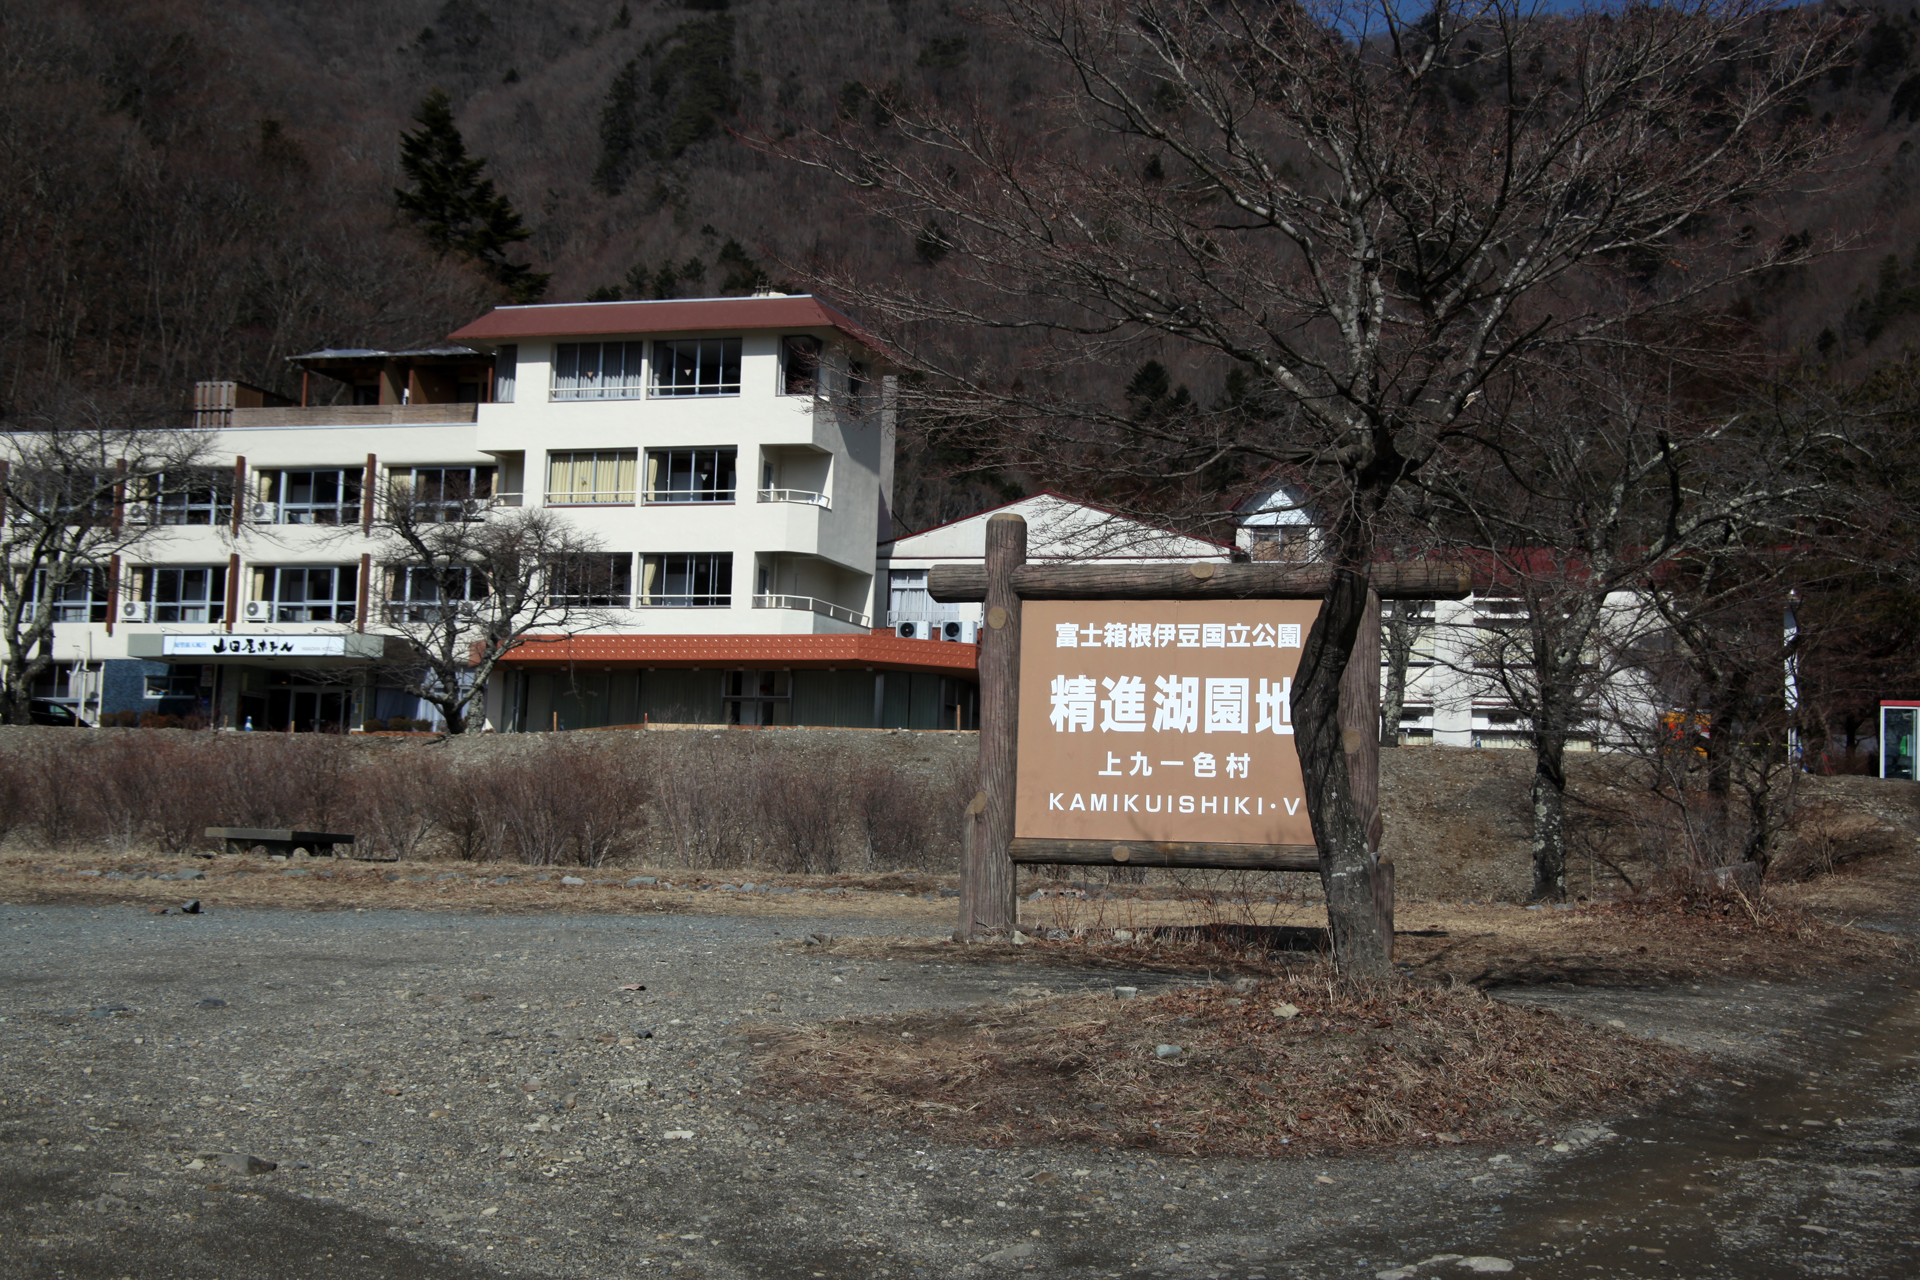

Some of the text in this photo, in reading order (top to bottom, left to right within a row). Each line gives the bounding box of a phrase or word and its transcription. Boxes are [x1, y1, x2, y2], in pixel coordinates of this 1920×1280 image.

[213, 637, 295, 653] 山田屋ホテル
[1055, 622, 1301, 649] 富士箱根伊豆国立公園
[1049, 674, 1295, 735] 精進湖園地
[1098, 751, 1251, 779] 上九一色村
